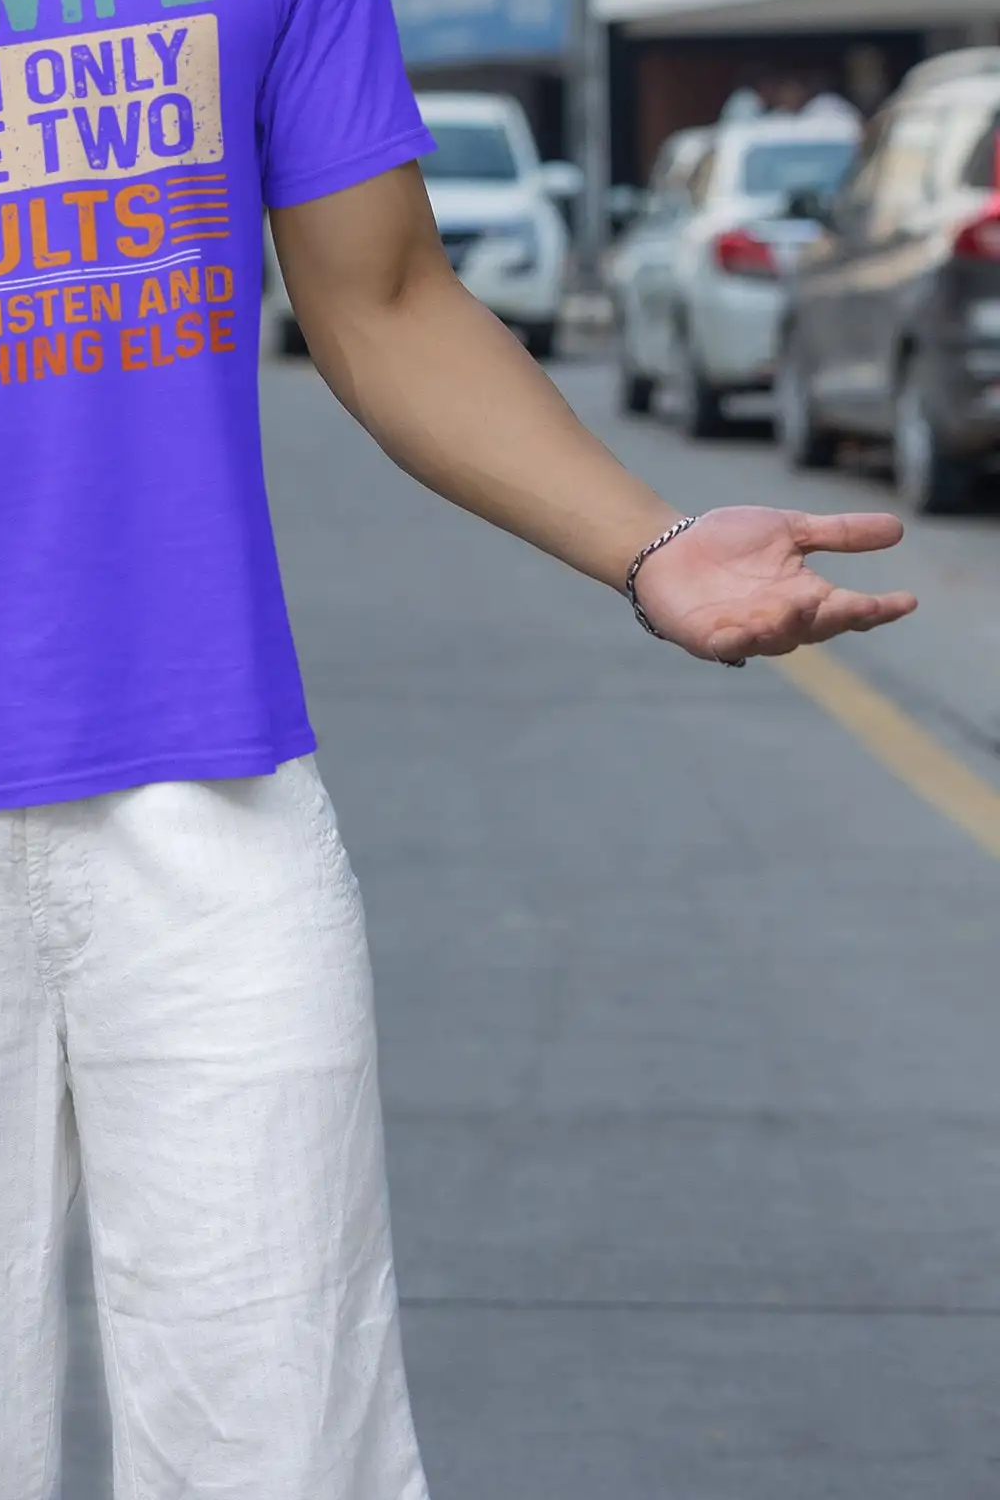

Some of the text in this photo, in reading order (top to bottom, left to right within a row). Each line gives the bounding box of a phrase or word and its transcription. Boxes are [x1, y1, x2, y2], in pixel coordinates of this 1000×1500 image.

[25, 28, 188, 103] ONLY
[28, 93, 195, 175] TWO
[138, 265, 235, 318] AND
[120, 310, 236, 372] ELSE
